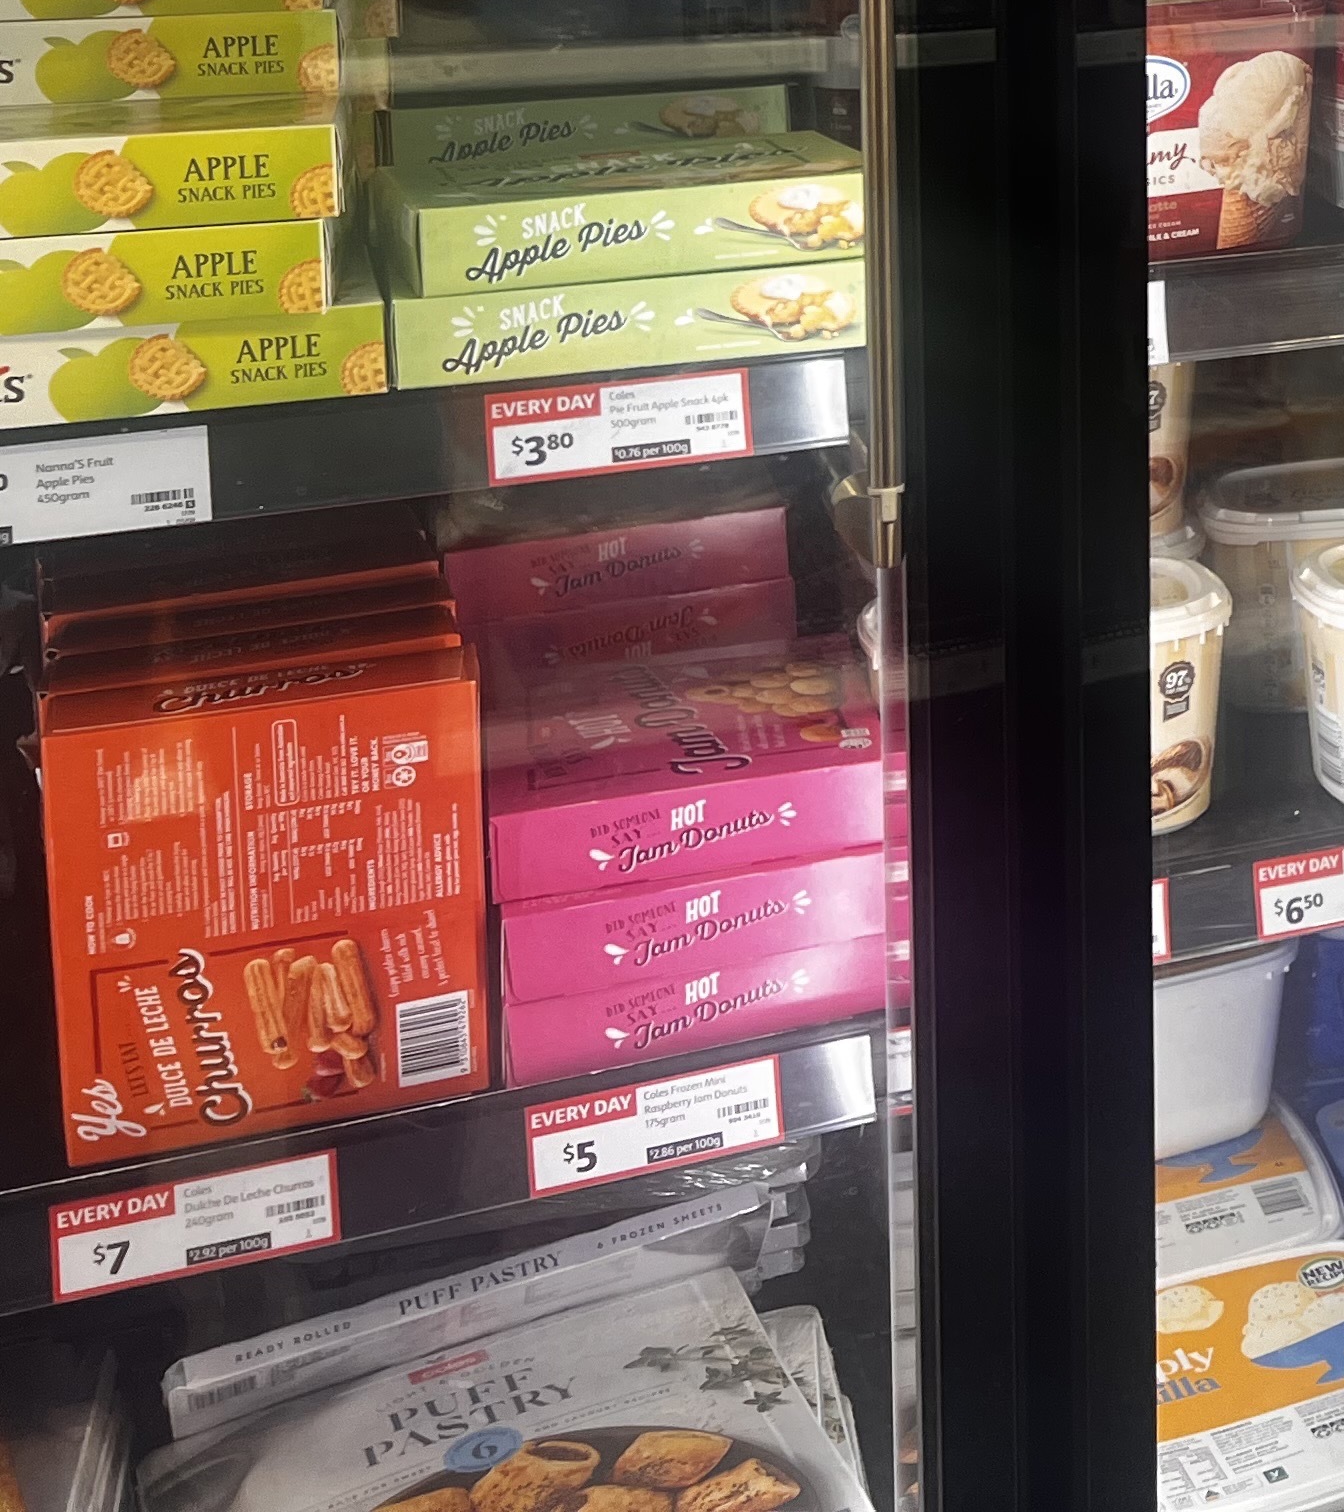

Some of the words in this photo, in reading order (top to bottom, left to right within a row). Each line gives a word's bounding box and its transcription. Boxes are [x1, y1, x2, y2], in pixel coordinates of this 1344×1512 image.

[520, 203, 588, 239] SNACK
[466, 234, 571, 284] Apple
[578, 217, 649, 253] Pies
[491, 398, 553, 419] EVERY
[556, 393, 596, 412] DAY
[651, 399, 679, 413] Apple
[681, 396, 708, 408] Snack
[87, 455, 114, 469] Fruit
[36, 476, 68, 491] Apple
[71, 474, 95, 486] Pies
[37, 491, 90, 504] 450gram
[671, 800, 706, 831] HOT
[618, 838, 679, 873] Jam
[678, 808, 775, 849] Donuts
[1258, 859, 1307, 883] EVERY
[1308, 854, 1339, 872] DAY
[135, 984, 169, 1031] LECHE
[150, 1034, 175, 1058] DE
[168, 948, 253, 1126] Churros
[156, 1062, 193, 1108] DULCE
[643, 1090, 666, 1102] Coles
[669, 1083, 702, 1097] Frozen
[704, 1076, 727, 1089] Mini
[643, 1099, 691, 1117] Raspberry
[693, 1094, 714, 1107] Jam
[715, 1084, 748, 1100] Donuts
[530, 1100, 591, 1130] EVERY
[594, 1094, 633, 1118] DAY
[57, 1199, 123, 1228] EVERY
[127, 1190, 169, 1215] DAY
[611, 1221, 667, 1248] FROZEN
[672, 1201, 725, 1231] SHEETS
[398, 1280, 463, 1316] PUFF
[470, 1251, 564, 1295] PASTRY
